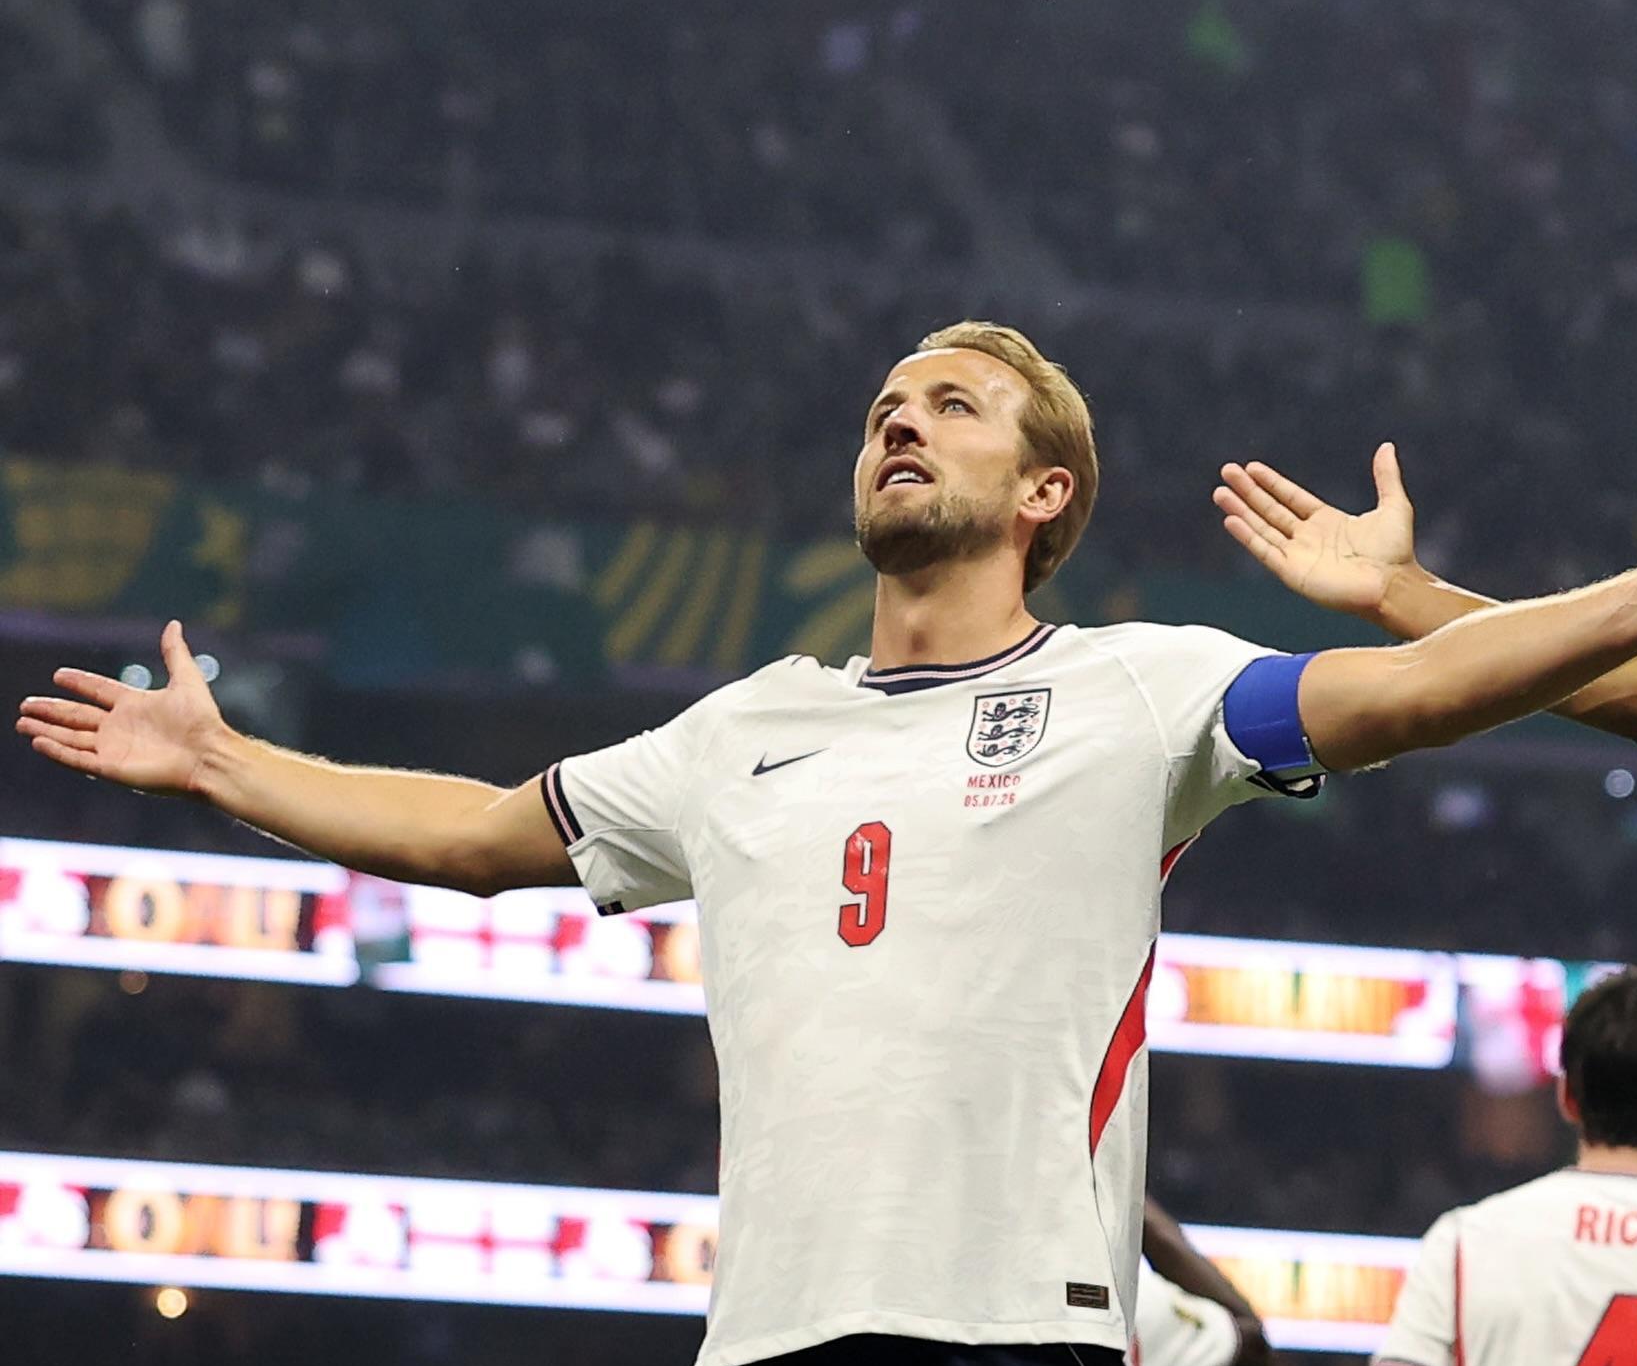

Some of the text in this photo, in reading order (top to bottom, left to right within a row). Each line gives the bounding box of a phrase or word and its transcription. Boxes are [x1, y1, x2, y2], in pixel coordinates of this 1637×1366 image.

[966, 774, 1021, 788] MEXICO
[963, 793, 1016, 807] 05.07.26
[837, 821, 892, 947] 9
